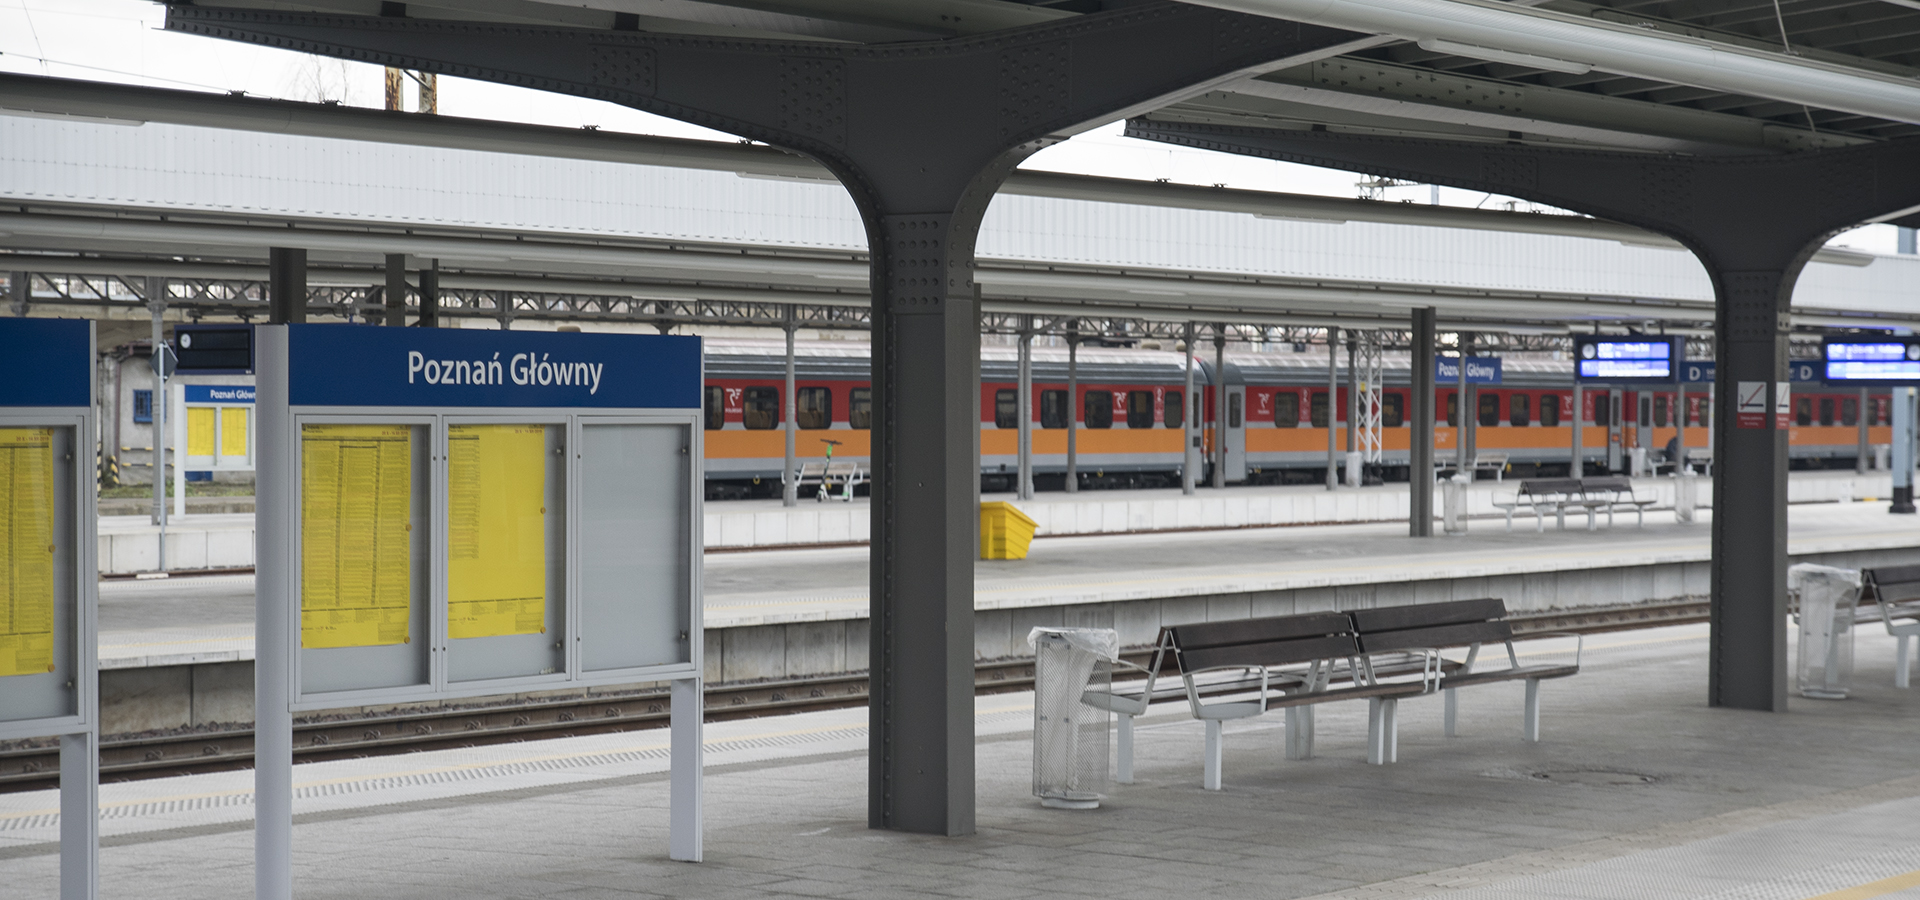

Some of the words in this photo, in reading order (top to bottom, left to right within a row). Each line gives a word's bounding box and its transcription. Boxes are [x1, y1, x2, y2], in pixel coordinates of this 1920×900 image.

[408, 351, 503, 385] Poznań
[510, 352, 604, 394] Główny
[1438, 362, 1459, 377] Pozn
[1466, 362, 1495, 381] Główny
[1688, 366, 1701, 381] D
[1800, 365, 1813, 380] D
[211, 389, 235, 399] Poznań
[236, 389, 256, 400] Główn
